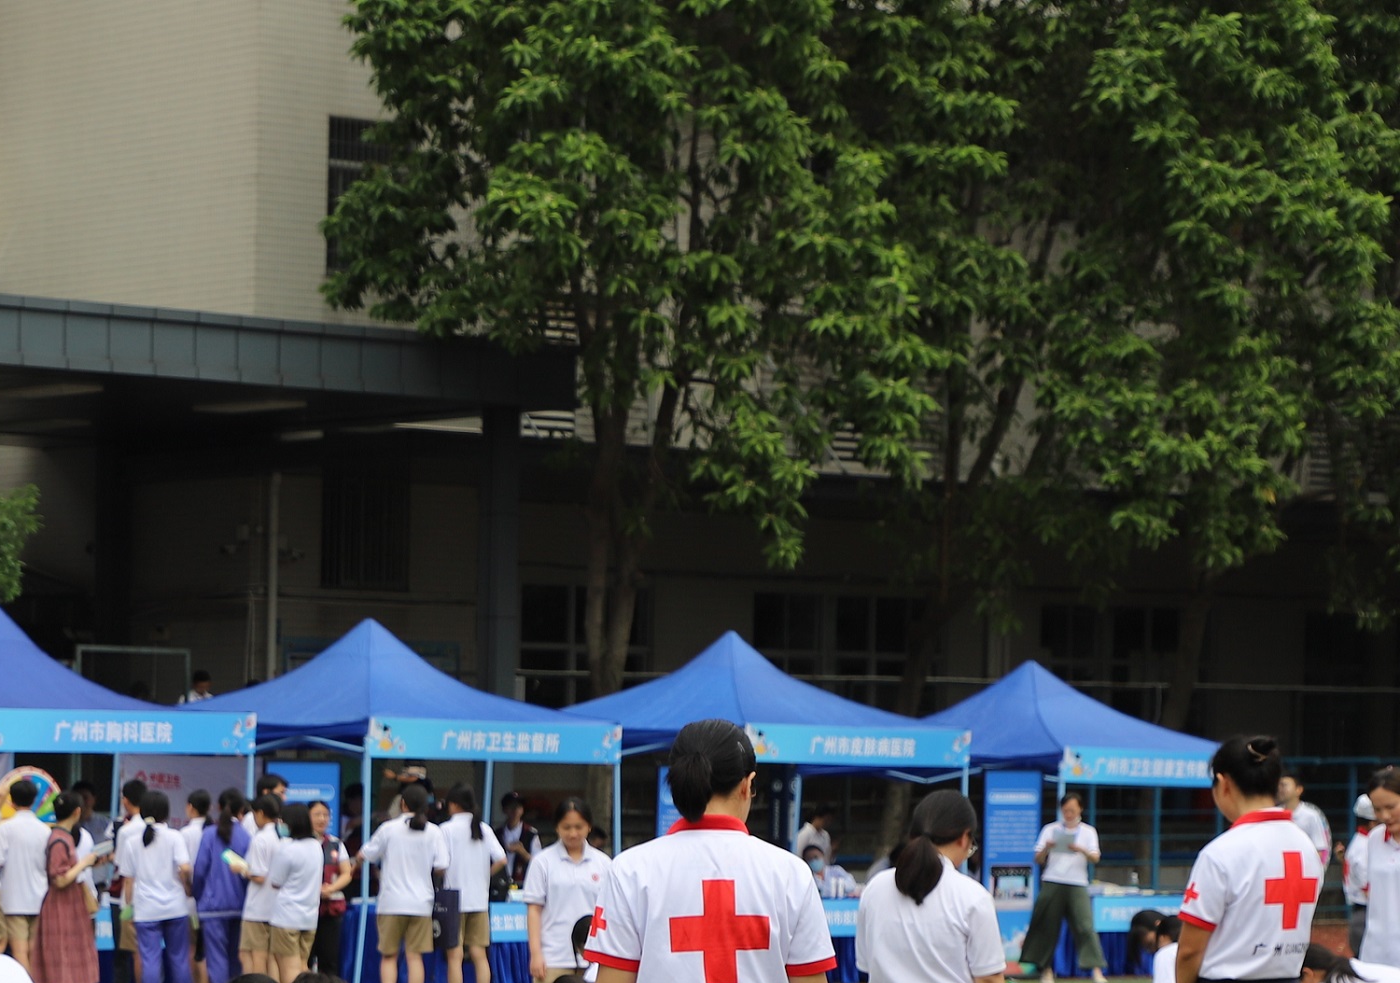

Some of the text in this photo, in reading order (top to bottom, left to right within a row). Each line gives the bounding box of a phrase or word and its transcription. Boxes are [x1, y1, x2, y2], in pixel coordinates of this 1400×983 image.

[55, 721, 173, 743] 广州市胸科医院
[441, 731, 560, 753] 广州市卫生监督所
[810, 736, 916, 758] 广州市皮肤病医院
[492, 914, 529, 931] 生监督
